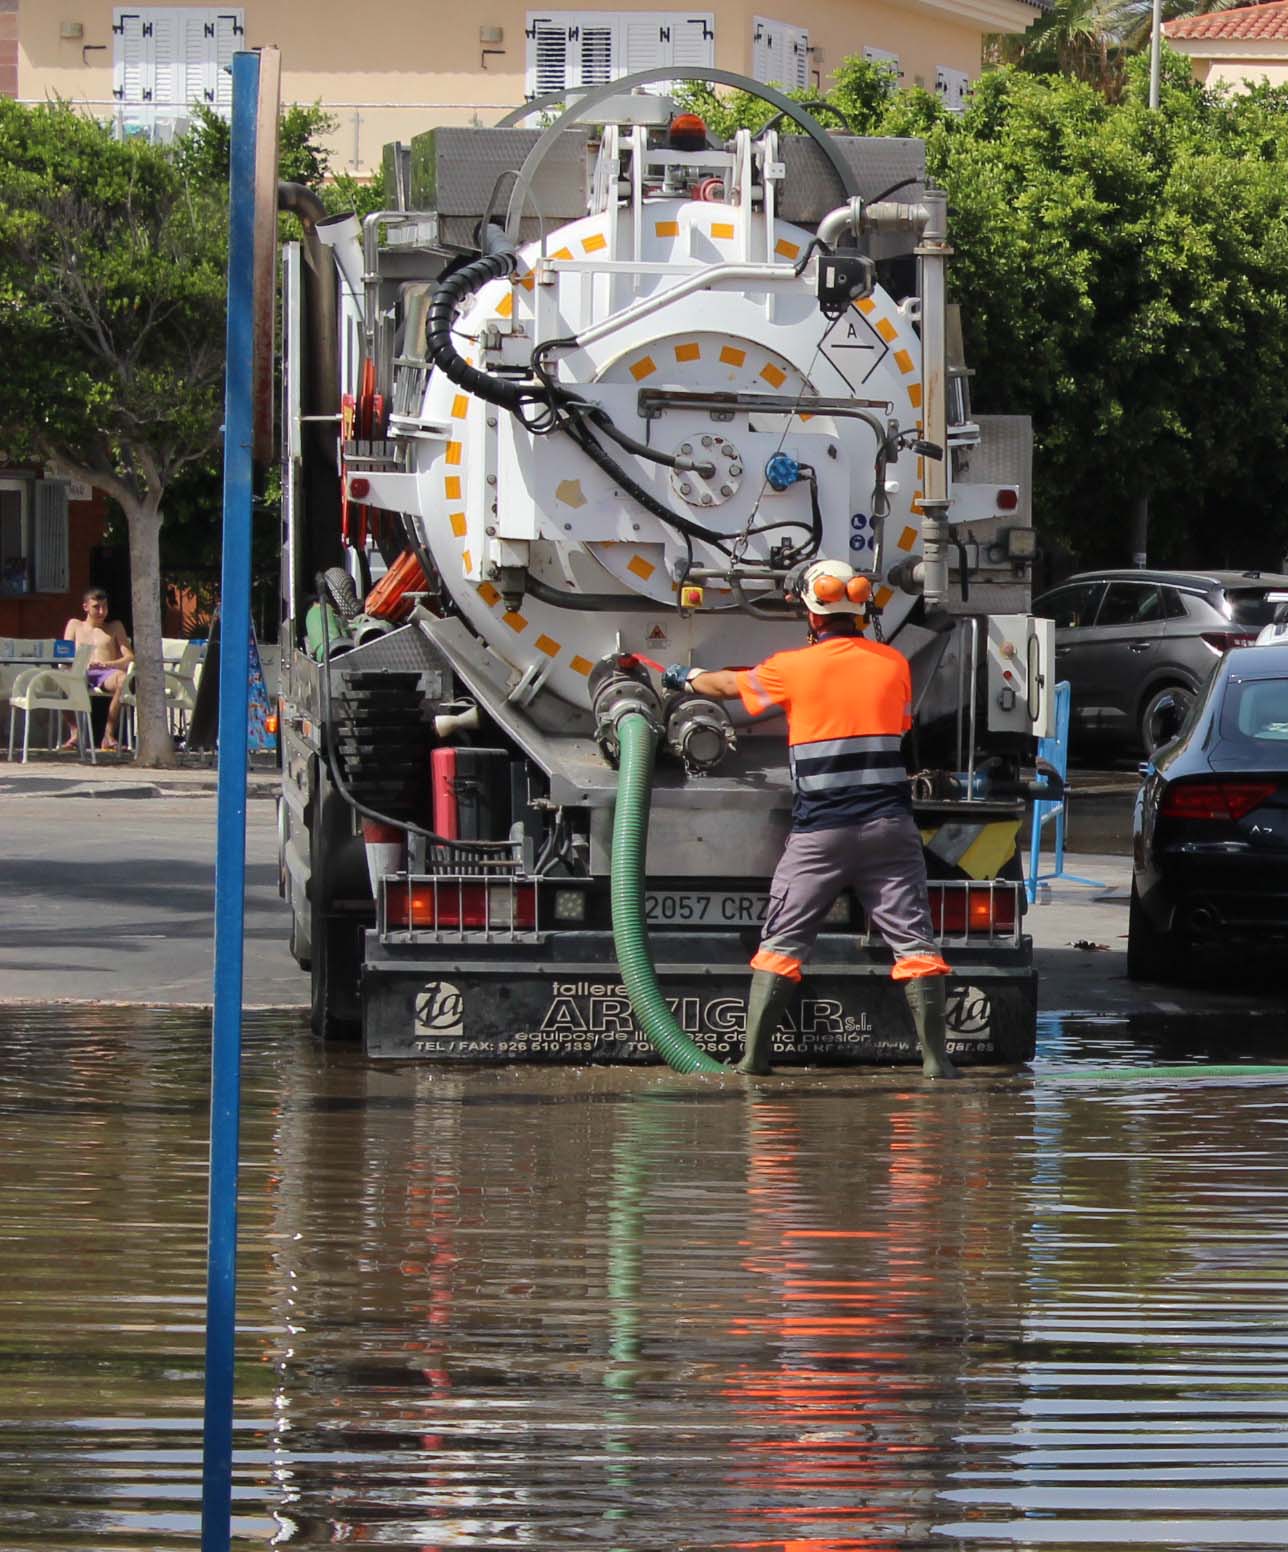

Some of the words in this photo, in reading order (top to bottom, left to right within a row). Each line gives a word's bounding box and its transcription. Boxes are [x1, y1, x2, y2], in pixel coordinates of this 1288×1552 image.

[847, 323, 857, 338] A
[646, 896, 711, 920] 2057
[721, 897, 769, 921] CRZ
[552, 982, 628, 996] tallere
[540, 996, 844, 1032] ARIGR
[514, 1031, 595, 1045] equipos
[601, 1031, 628, 1041] de
[416, 1041, 446, 1051] TEL
[460, 1041, 495, 1051] FAX:
[499, 1041, 528, 1051] 926
[531, 1041, 560, 1051] 510
[564, 1042, 592, 1052] 133
